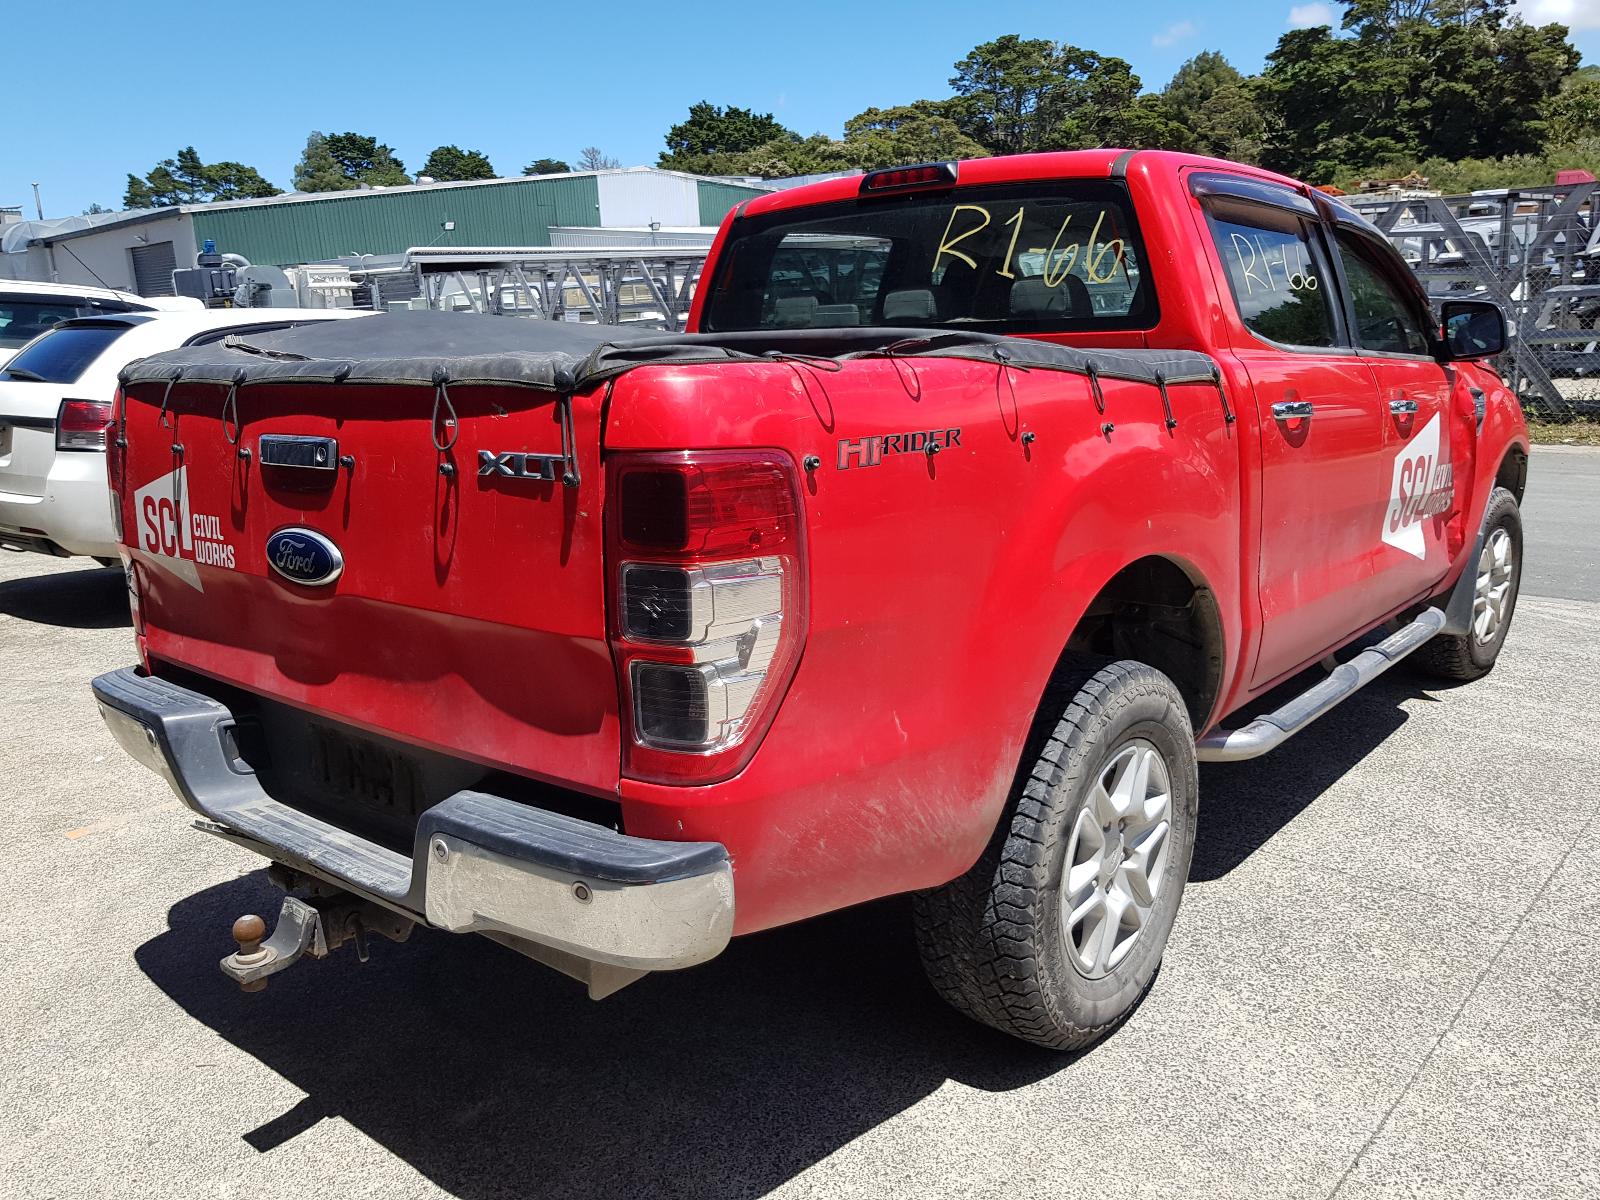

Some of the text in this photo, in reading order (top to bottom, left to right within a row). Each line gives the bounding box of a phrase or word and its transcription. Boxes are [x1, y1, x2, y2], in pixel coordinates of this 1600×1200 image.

[932, 205, 1125, 287] R1-66
[477, 450, 572, 480] XLT
[1390, 455, 1432, 533] SCL
[143, 495, 193, 562] SCL
[192, 513, 225, 541] CIVIL
[194, 539, 236, 569] WORKS
[276, 538, 316, 574] Ford
